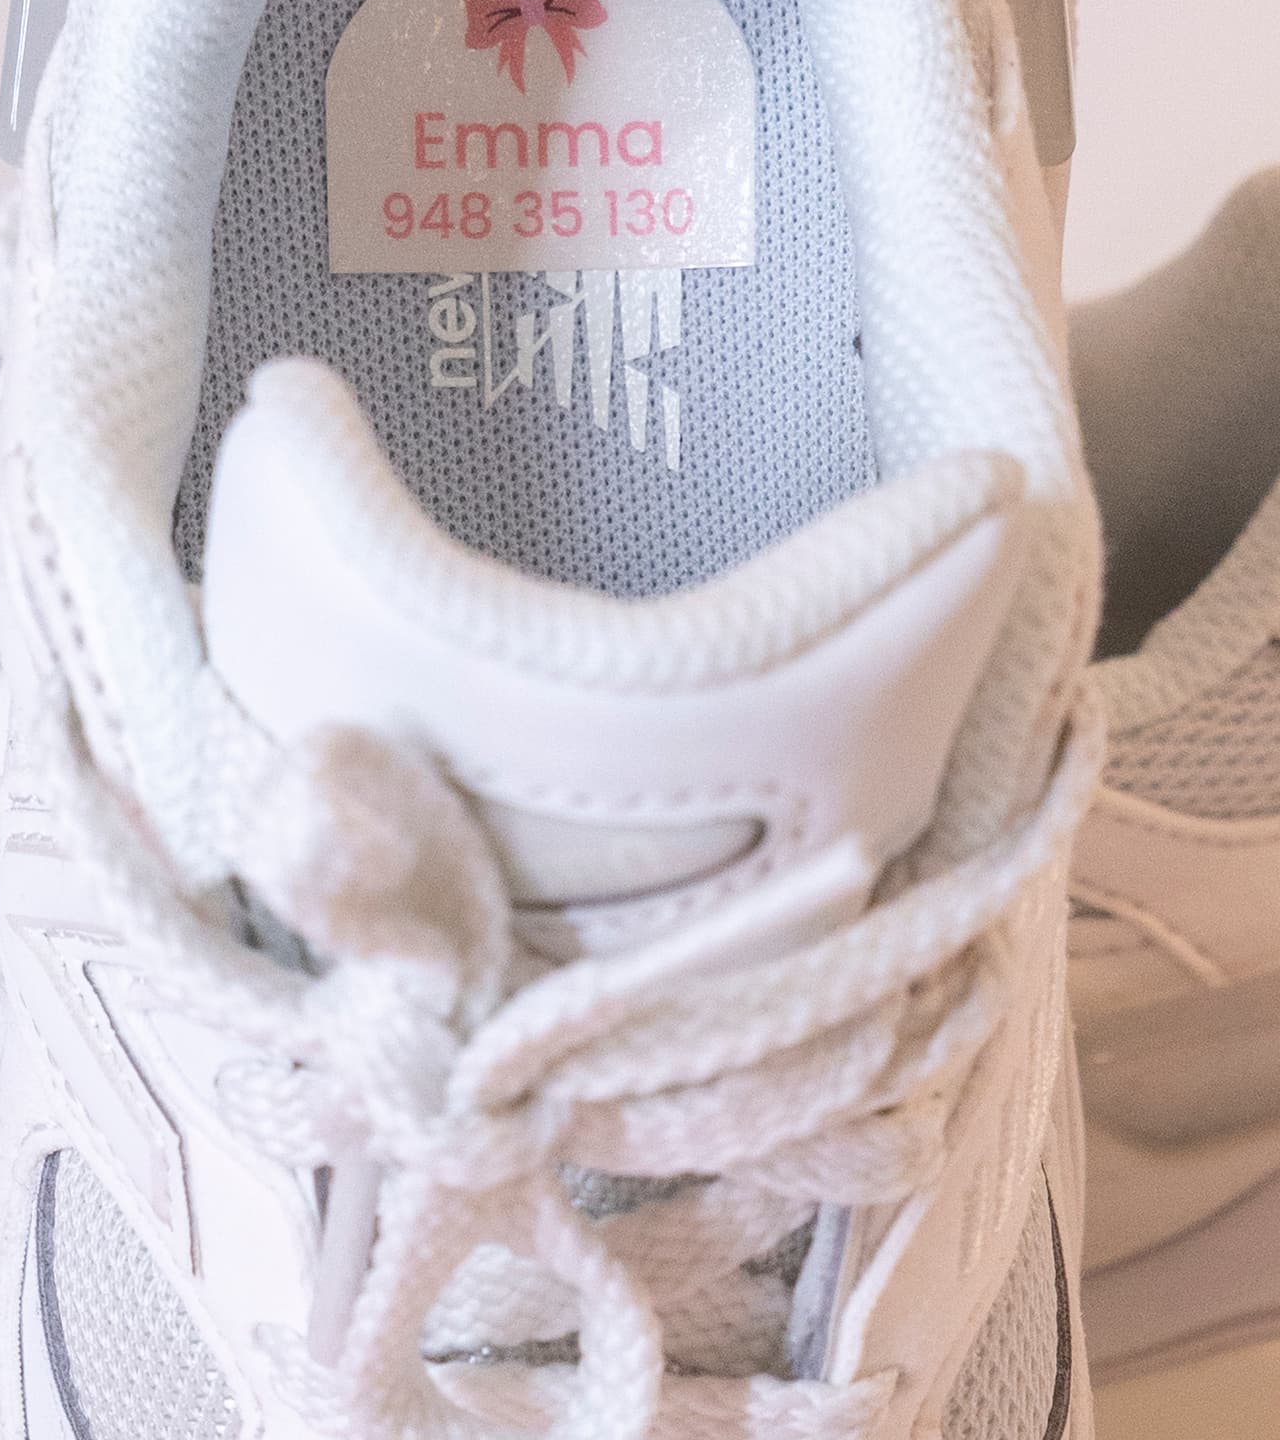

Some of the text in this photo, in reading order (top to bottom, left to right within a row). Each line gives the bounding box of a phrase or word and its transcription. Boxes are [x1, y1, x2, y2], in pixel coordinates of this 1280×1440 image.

[415, 112, 662, 169] Emma
[383, 188, 693, 239] 948 35 130
